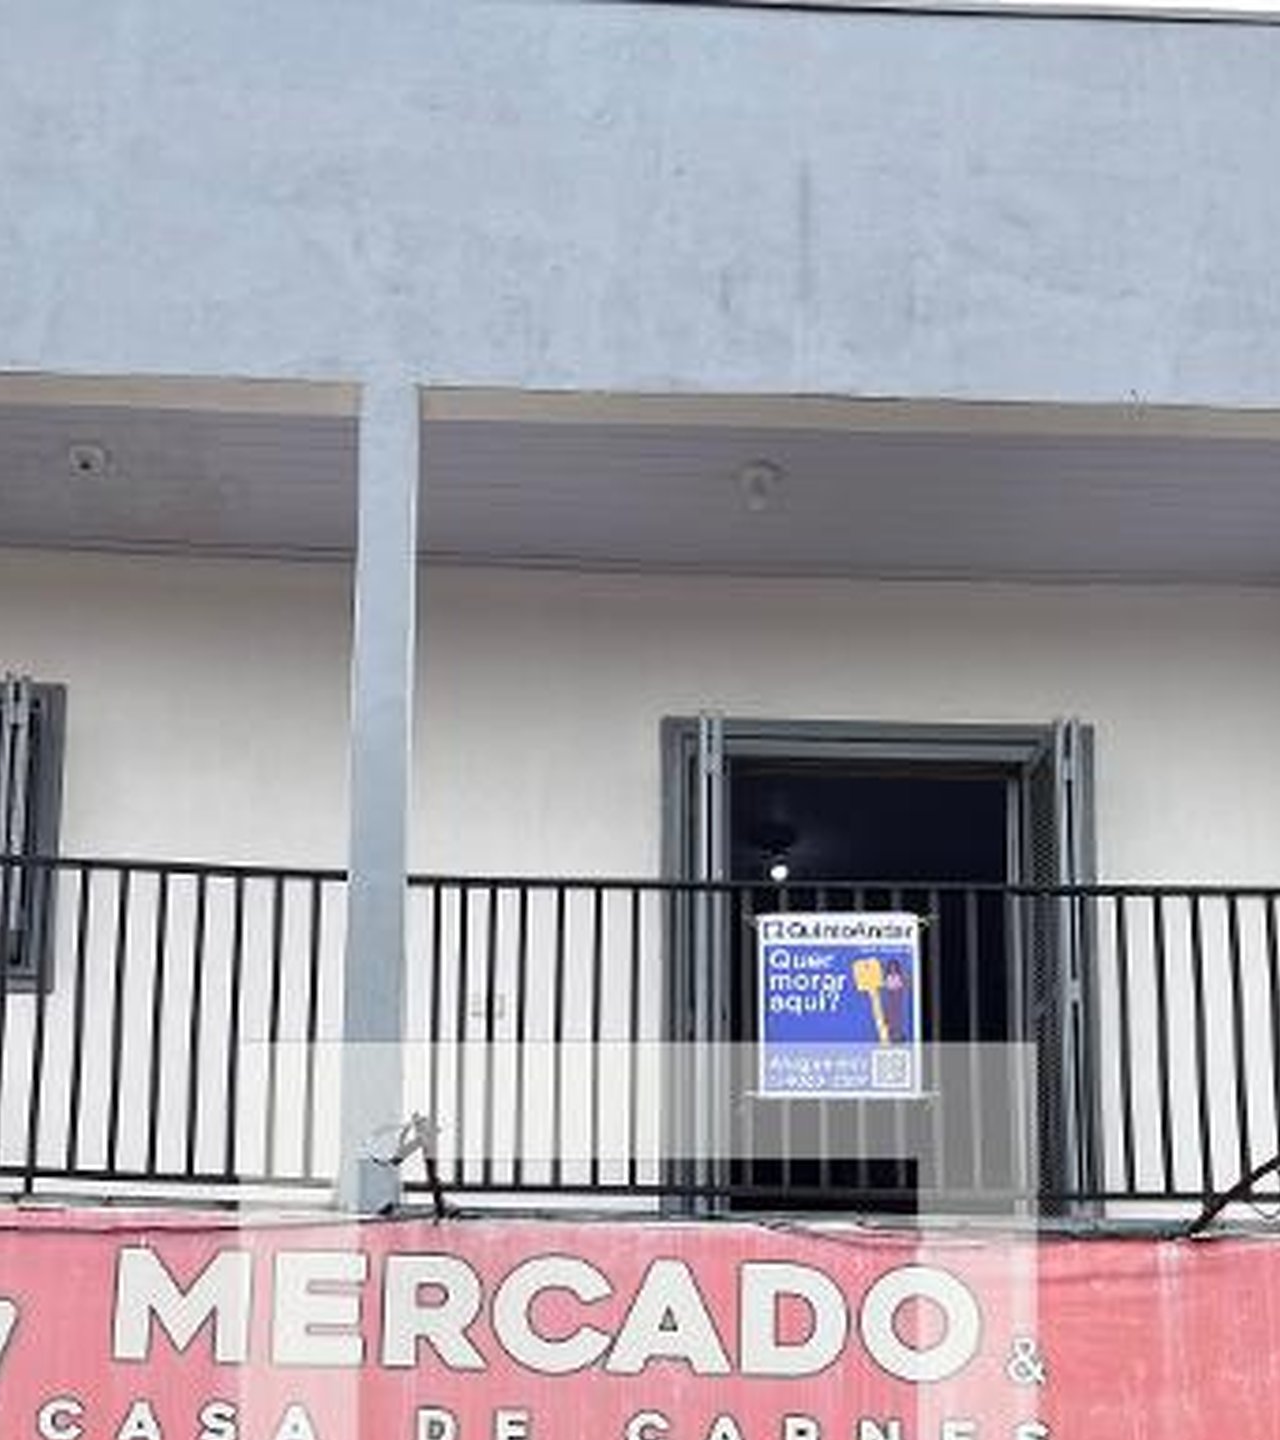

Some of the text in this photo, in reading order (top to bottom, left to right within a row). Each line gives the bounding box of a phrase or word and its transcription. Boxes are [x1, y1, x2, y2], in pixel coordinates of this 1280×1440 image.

[770, 949, 833, 969] Quer
[770, 973, 847, 991] morar
[769, 992, 841, 1014] aqui?
[108, 1244, 1048, 1386] MERCADO &
